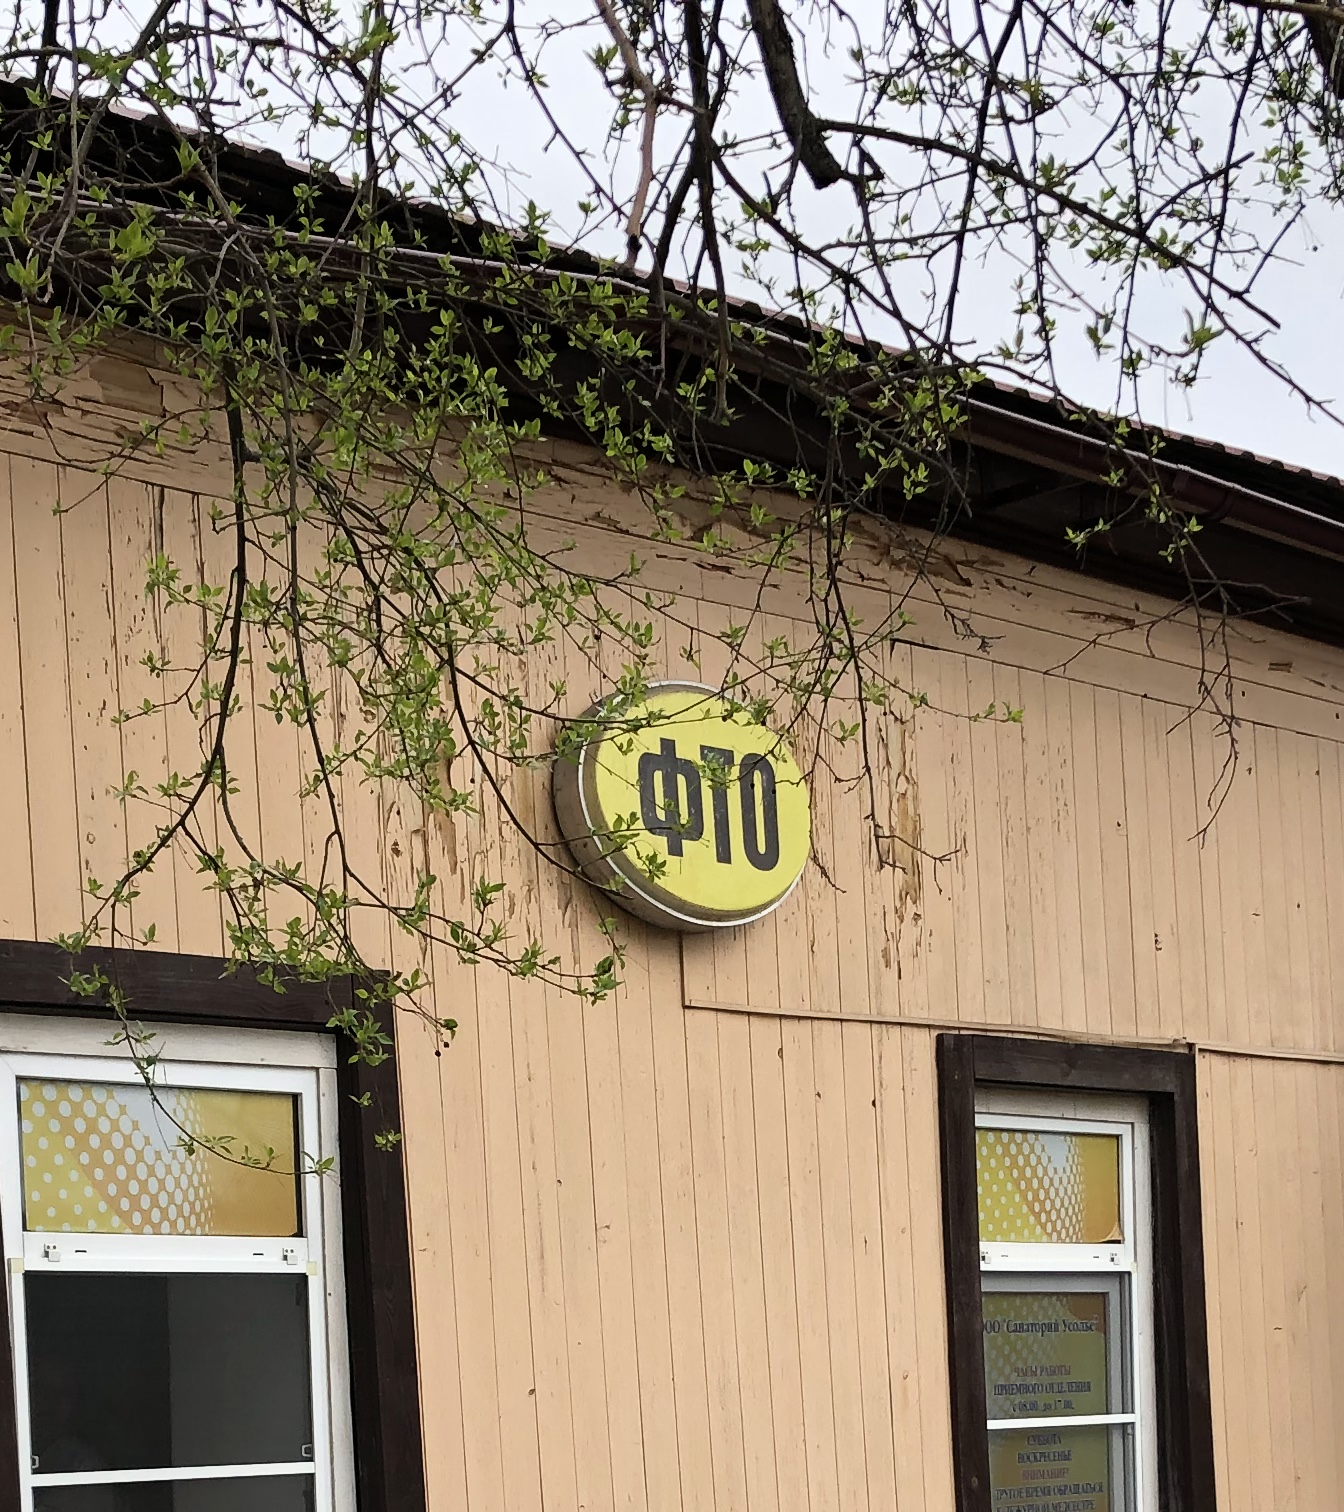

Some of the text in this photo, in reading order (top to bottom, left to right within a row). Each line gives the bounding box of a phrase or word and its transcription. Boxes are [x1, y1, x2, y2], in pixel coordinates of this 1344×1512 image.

[638, 737, 779, 872] ФТО
[983, 1320, 1000, 1334] ОО
[1040, 1365, 1071, 1376] РАБОТЫ
[1027, 1434, 1061, 1446] СУББОТА
[1018, 1450, 1072, 1464] ВОСКРЕСЕНЬЕ
